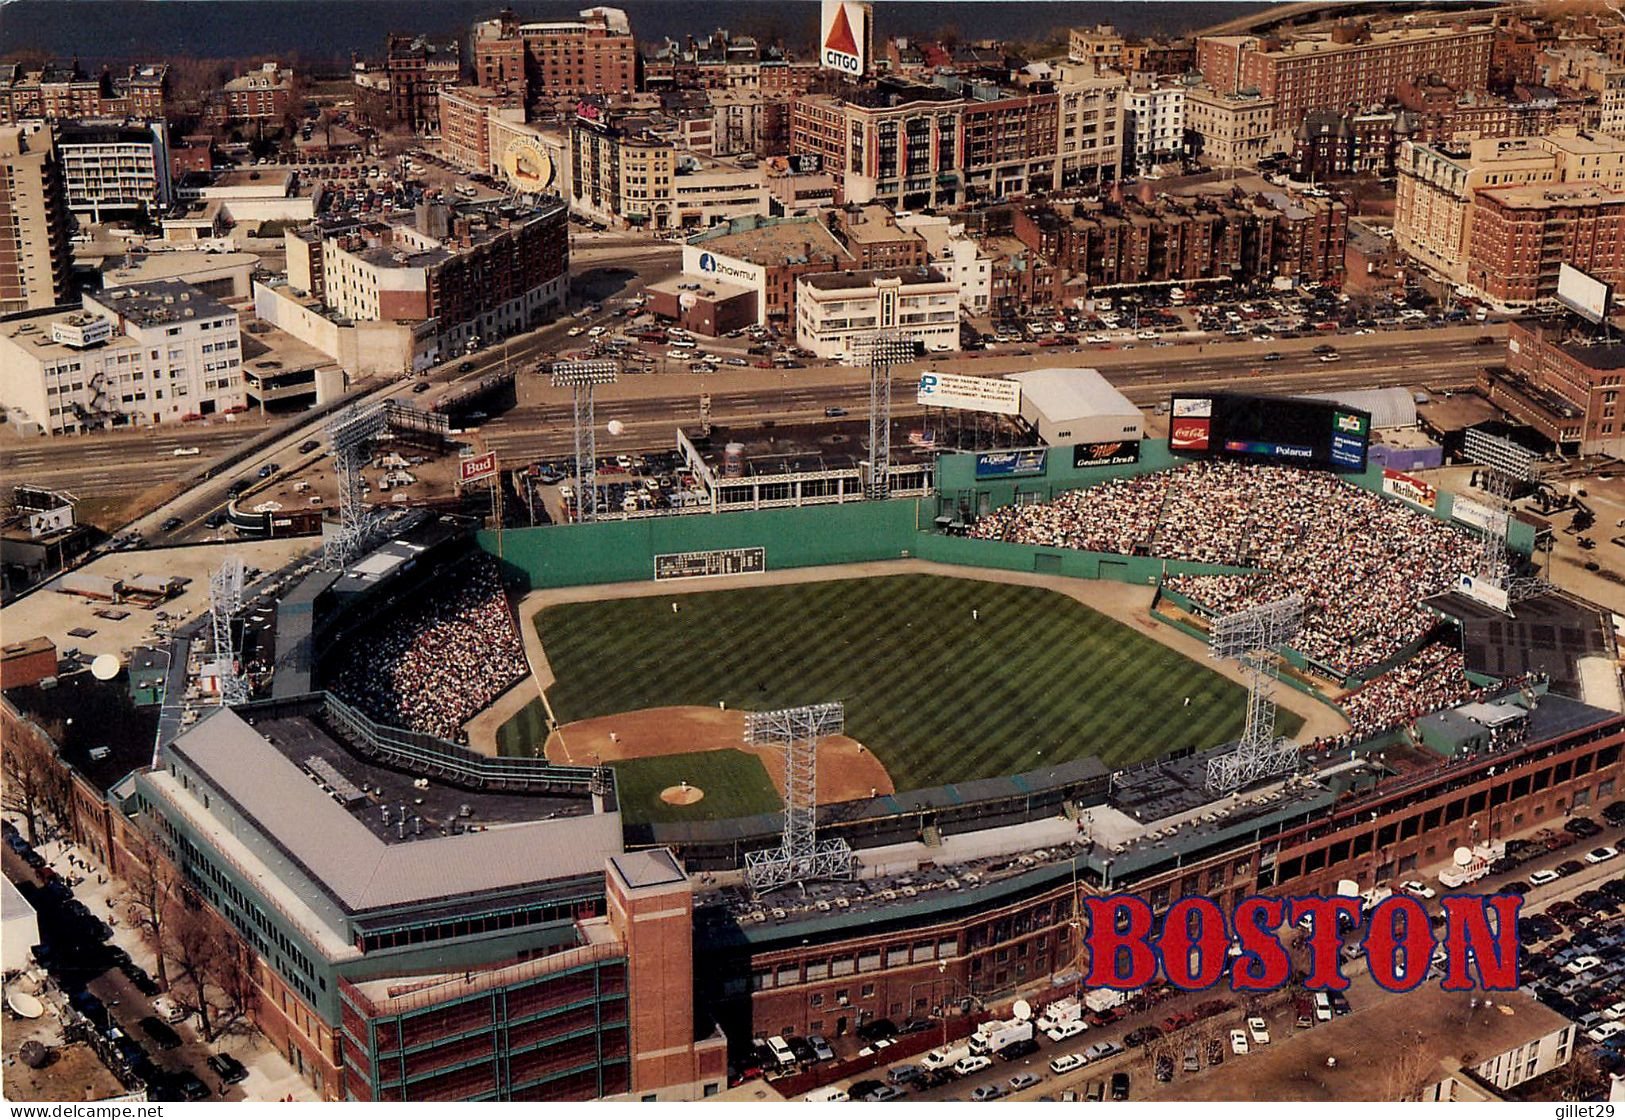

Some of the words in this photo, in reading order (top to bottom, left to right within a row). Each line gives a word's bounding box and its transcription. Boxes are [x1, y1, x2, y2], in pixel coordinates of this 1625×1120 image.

[827, 51, 858, 71] CITGO
[717, 262, 757, 281] Shawmut
[1275, 446, 1312, 457] Polaroid
[466, 457, 491, 475] Bud
[1077, 459, 1111, 467] Genuine
[1112, 456, 1135, 464] Draft
